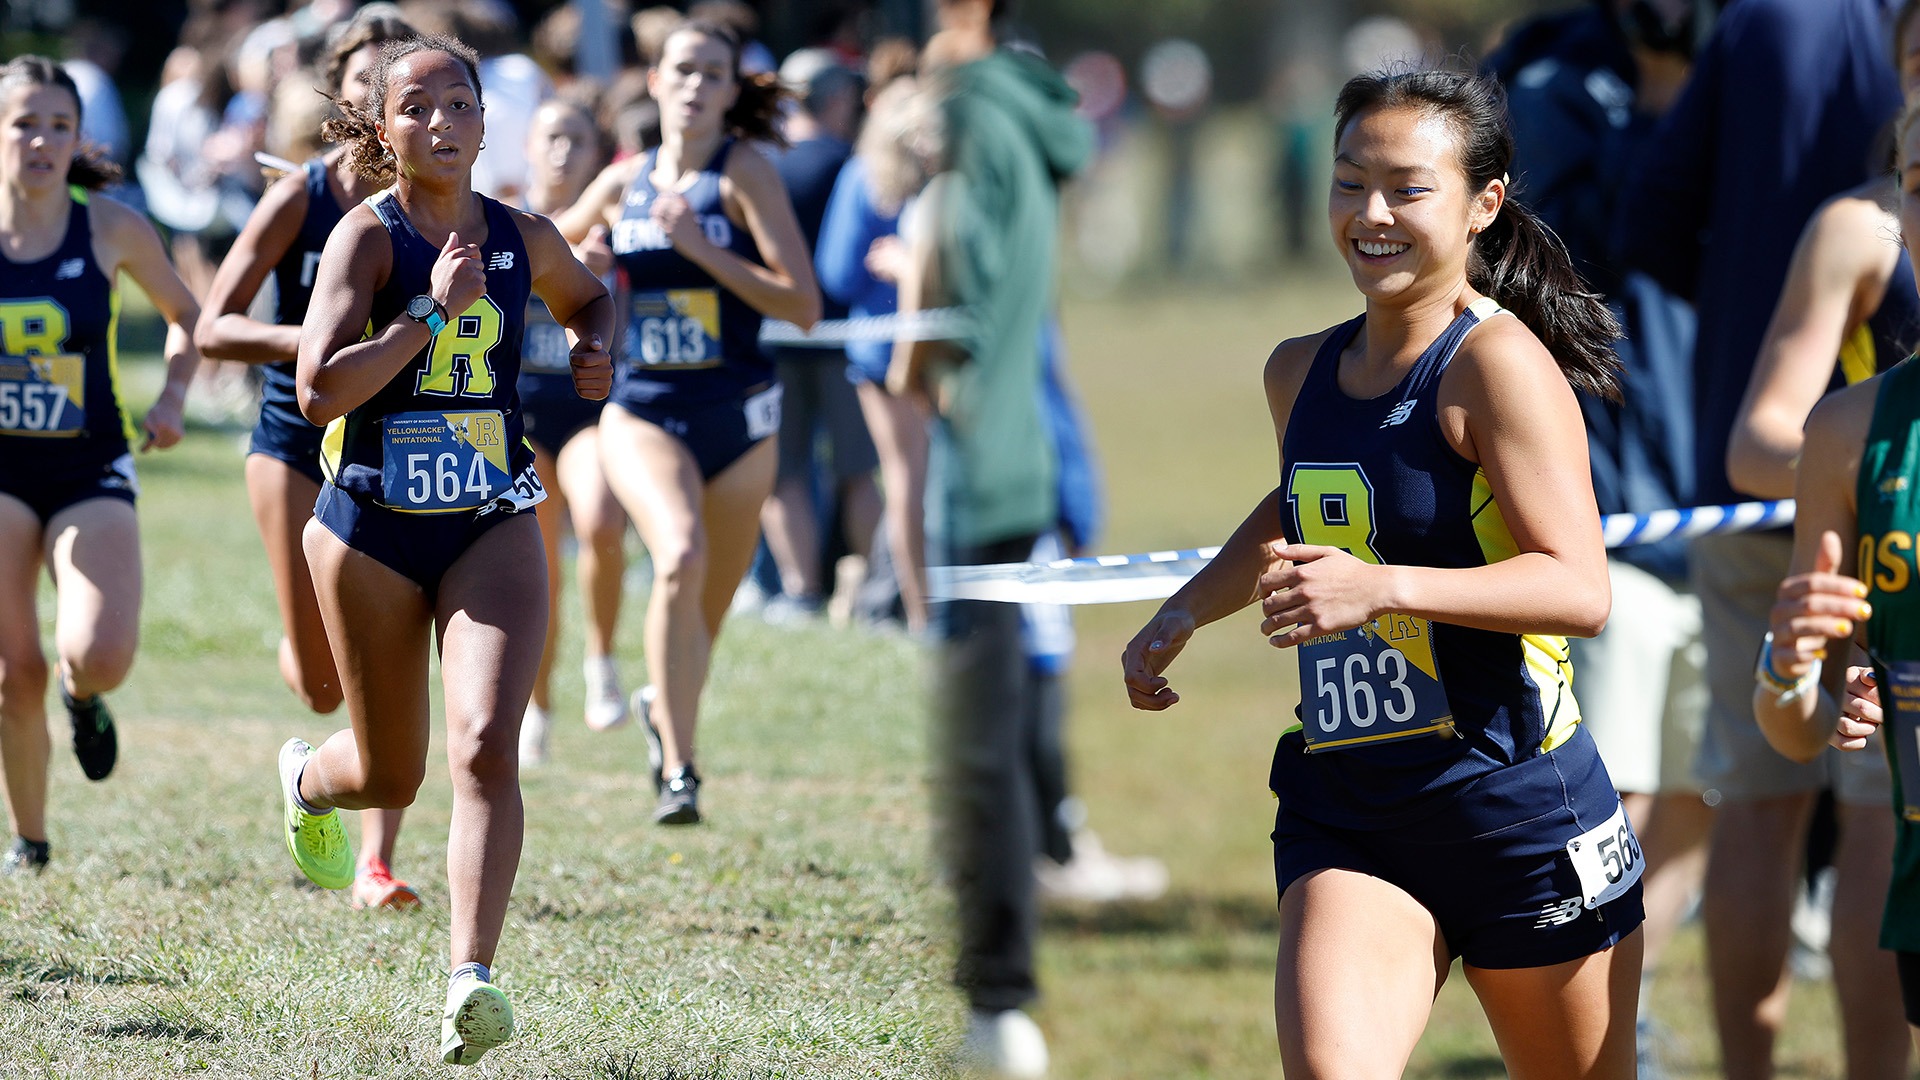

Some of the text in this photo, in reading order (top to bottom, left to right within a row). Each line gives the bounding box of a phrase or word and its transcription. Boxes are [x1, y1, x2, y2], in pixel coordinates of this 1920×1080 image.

[0, 296, 71, 357] R
[413, 294, 504, 398] R
[641, 316, 706, 365] 613
[0, 382, 68, 430] 557
[387, 426, 446, 435] YELLOWJACKET
[391, 436, 442, 444] INVITATIONAL
[475, 417, 499, 446] R
[407, 452, 493, 504] 564
[1287, 462, 1387, 566] R
[1303, 631, 1347, 647] INVITATIONAL
[1316, 648, 1416, 733] 563
